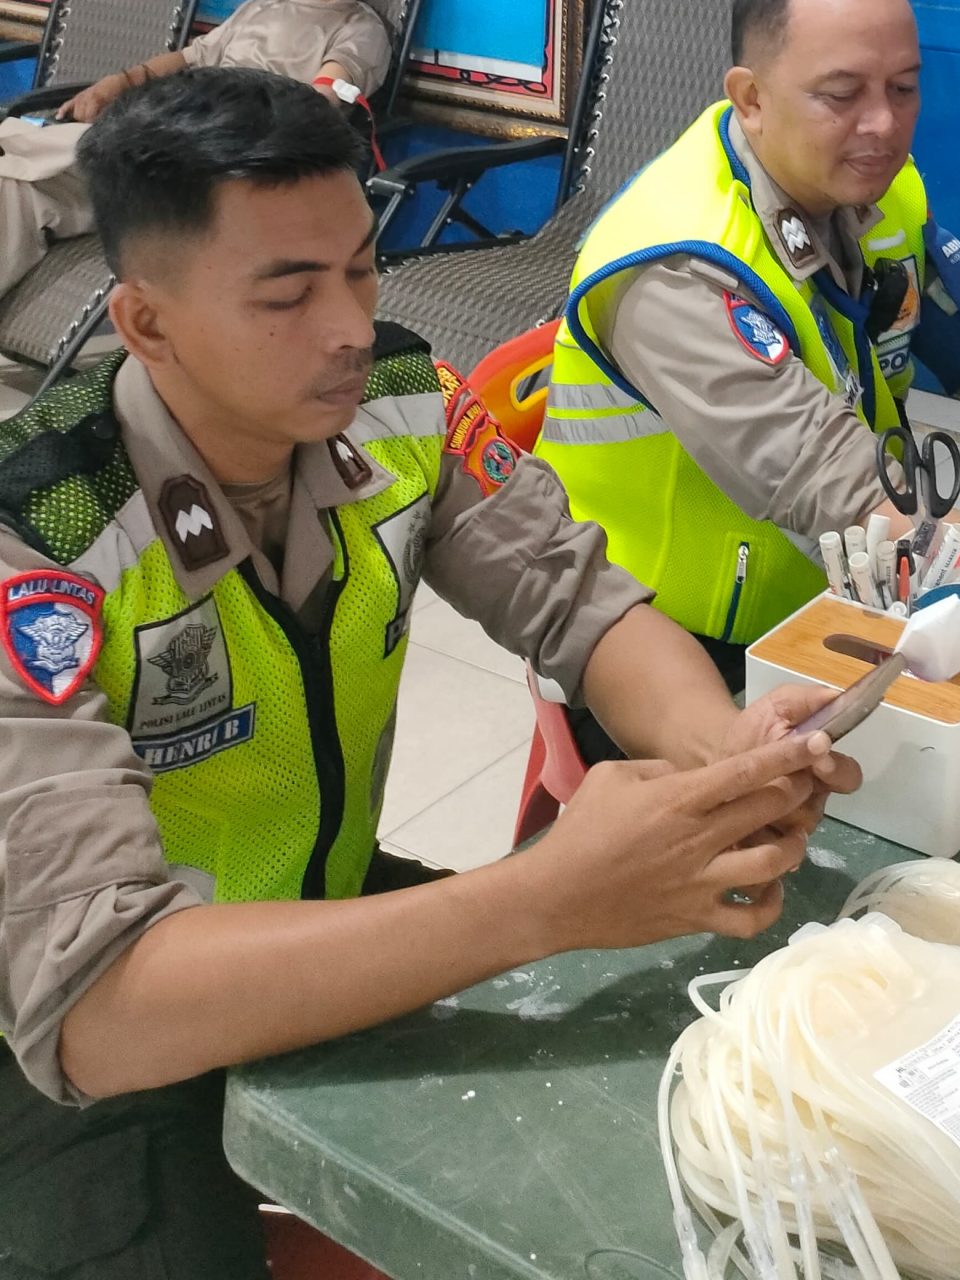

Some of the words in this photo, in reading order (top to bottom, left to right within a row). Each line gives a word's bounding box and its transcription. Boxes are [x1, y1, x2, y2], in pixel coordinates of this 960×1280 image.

[8, 579, 48, 601] LALU
[50, 579, 95, 605] LINTAS
[144, 726, 219, 765] HENRI
[224, 720, 240, 740] B
